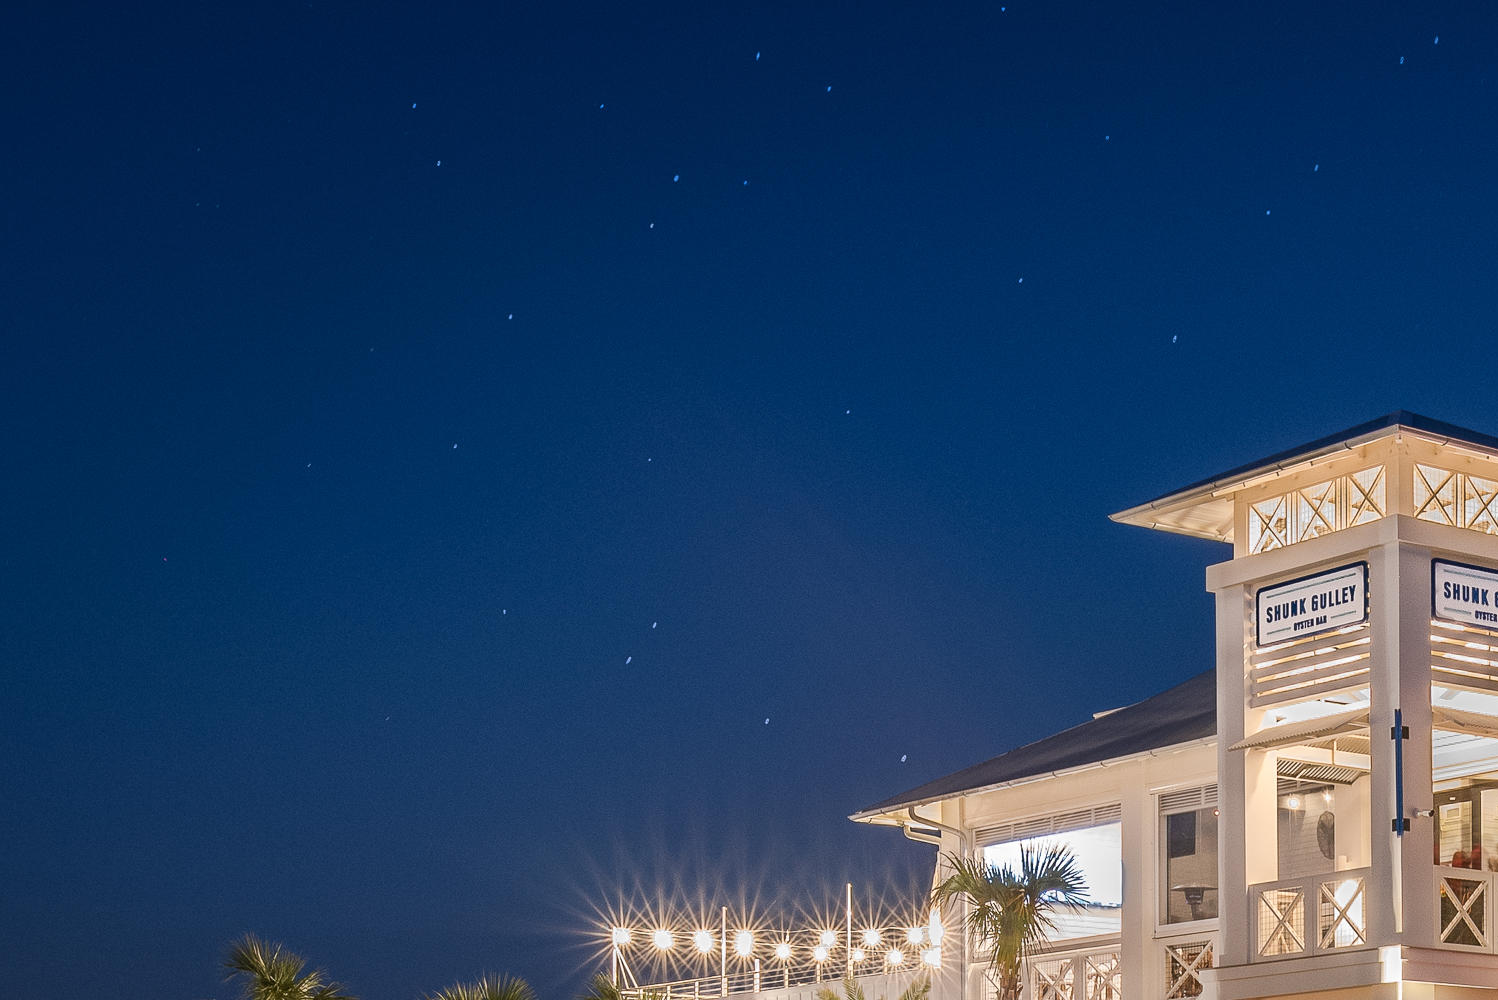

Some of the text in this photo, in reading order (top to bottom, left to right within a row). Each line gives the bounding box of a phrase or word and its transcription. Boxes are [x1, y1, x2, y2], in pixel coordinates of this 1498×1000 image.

[1444, 581, 1489, 606] SHUNK
[1266, 585, 1356, 623] SHUNK GULLEY
[1293, 615, 1327, 631] OYSTER BAR
[1475, 610, 1498, 622] OYSTER
